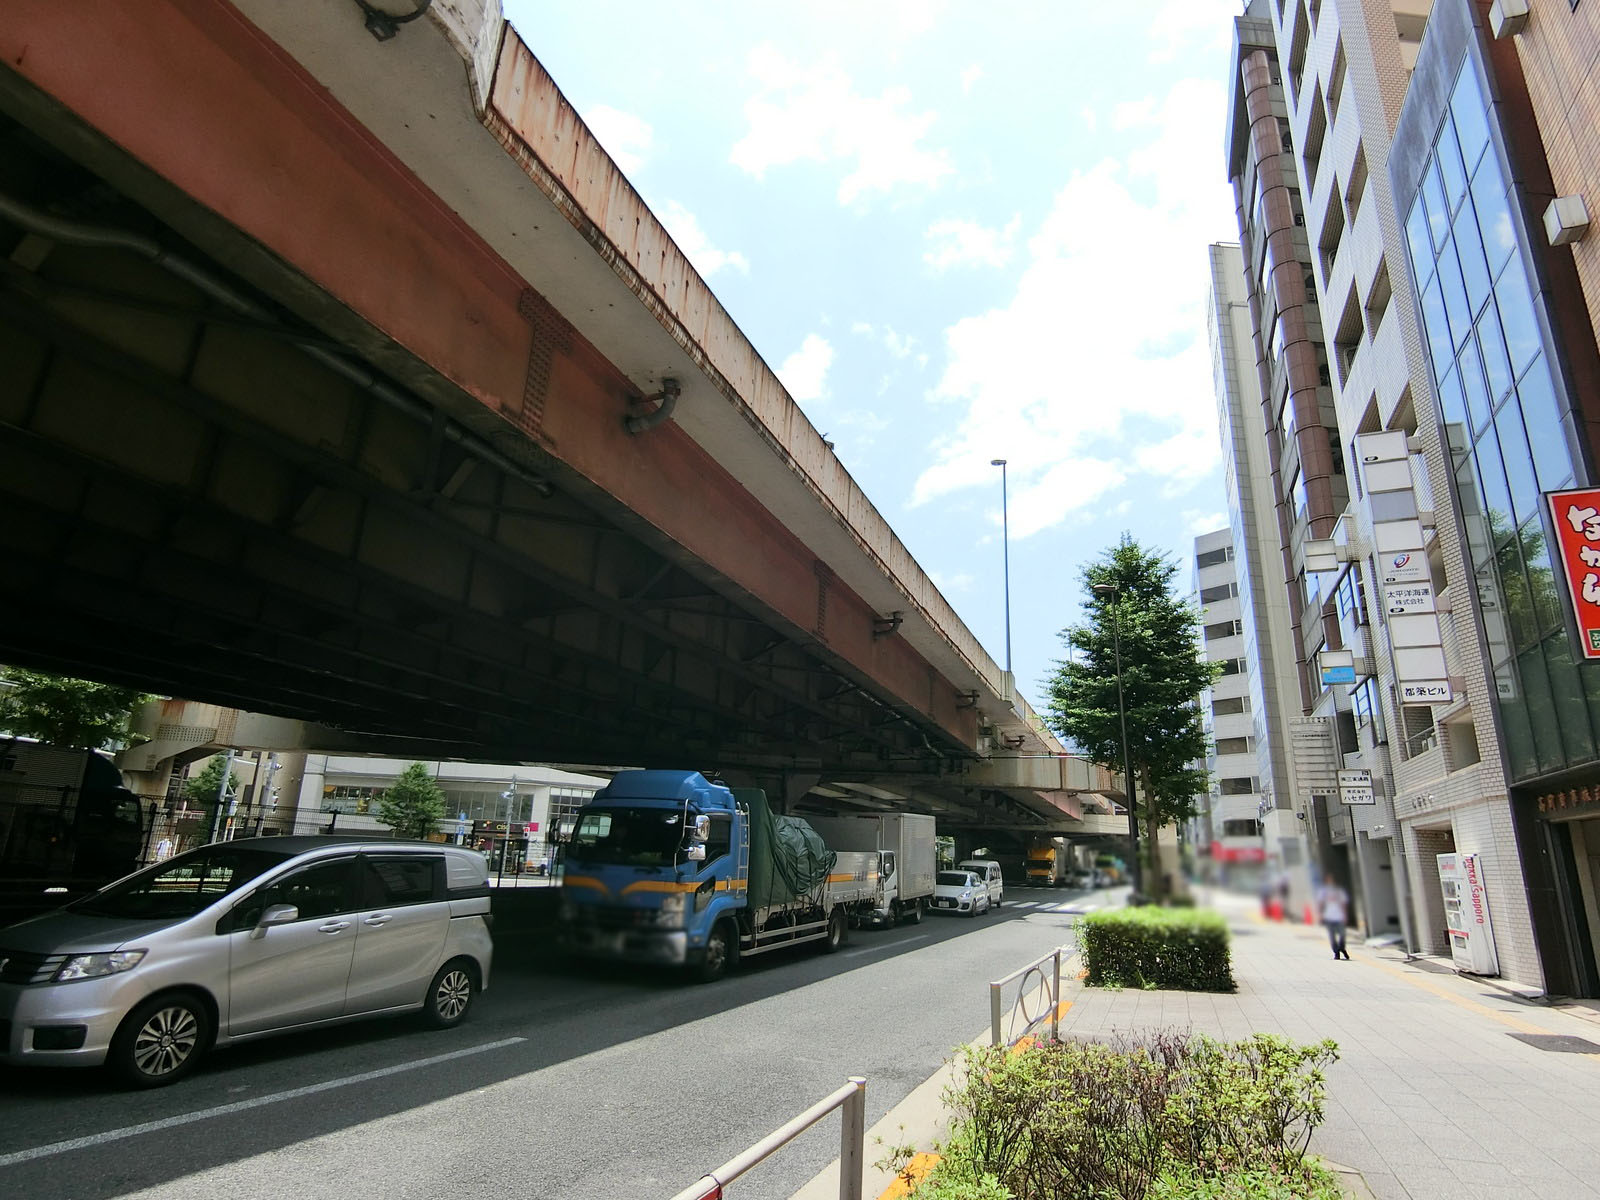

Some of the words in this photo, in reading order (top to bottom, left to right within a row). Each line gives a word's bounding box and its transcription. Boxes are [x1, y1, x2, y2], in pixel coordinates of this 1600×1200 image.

[1387, 589, 1430, 599] 太平洋海運
[1395, 598, 1425, 606] 株式会社
[1405, 687, 1447, 697] 都築ビル
